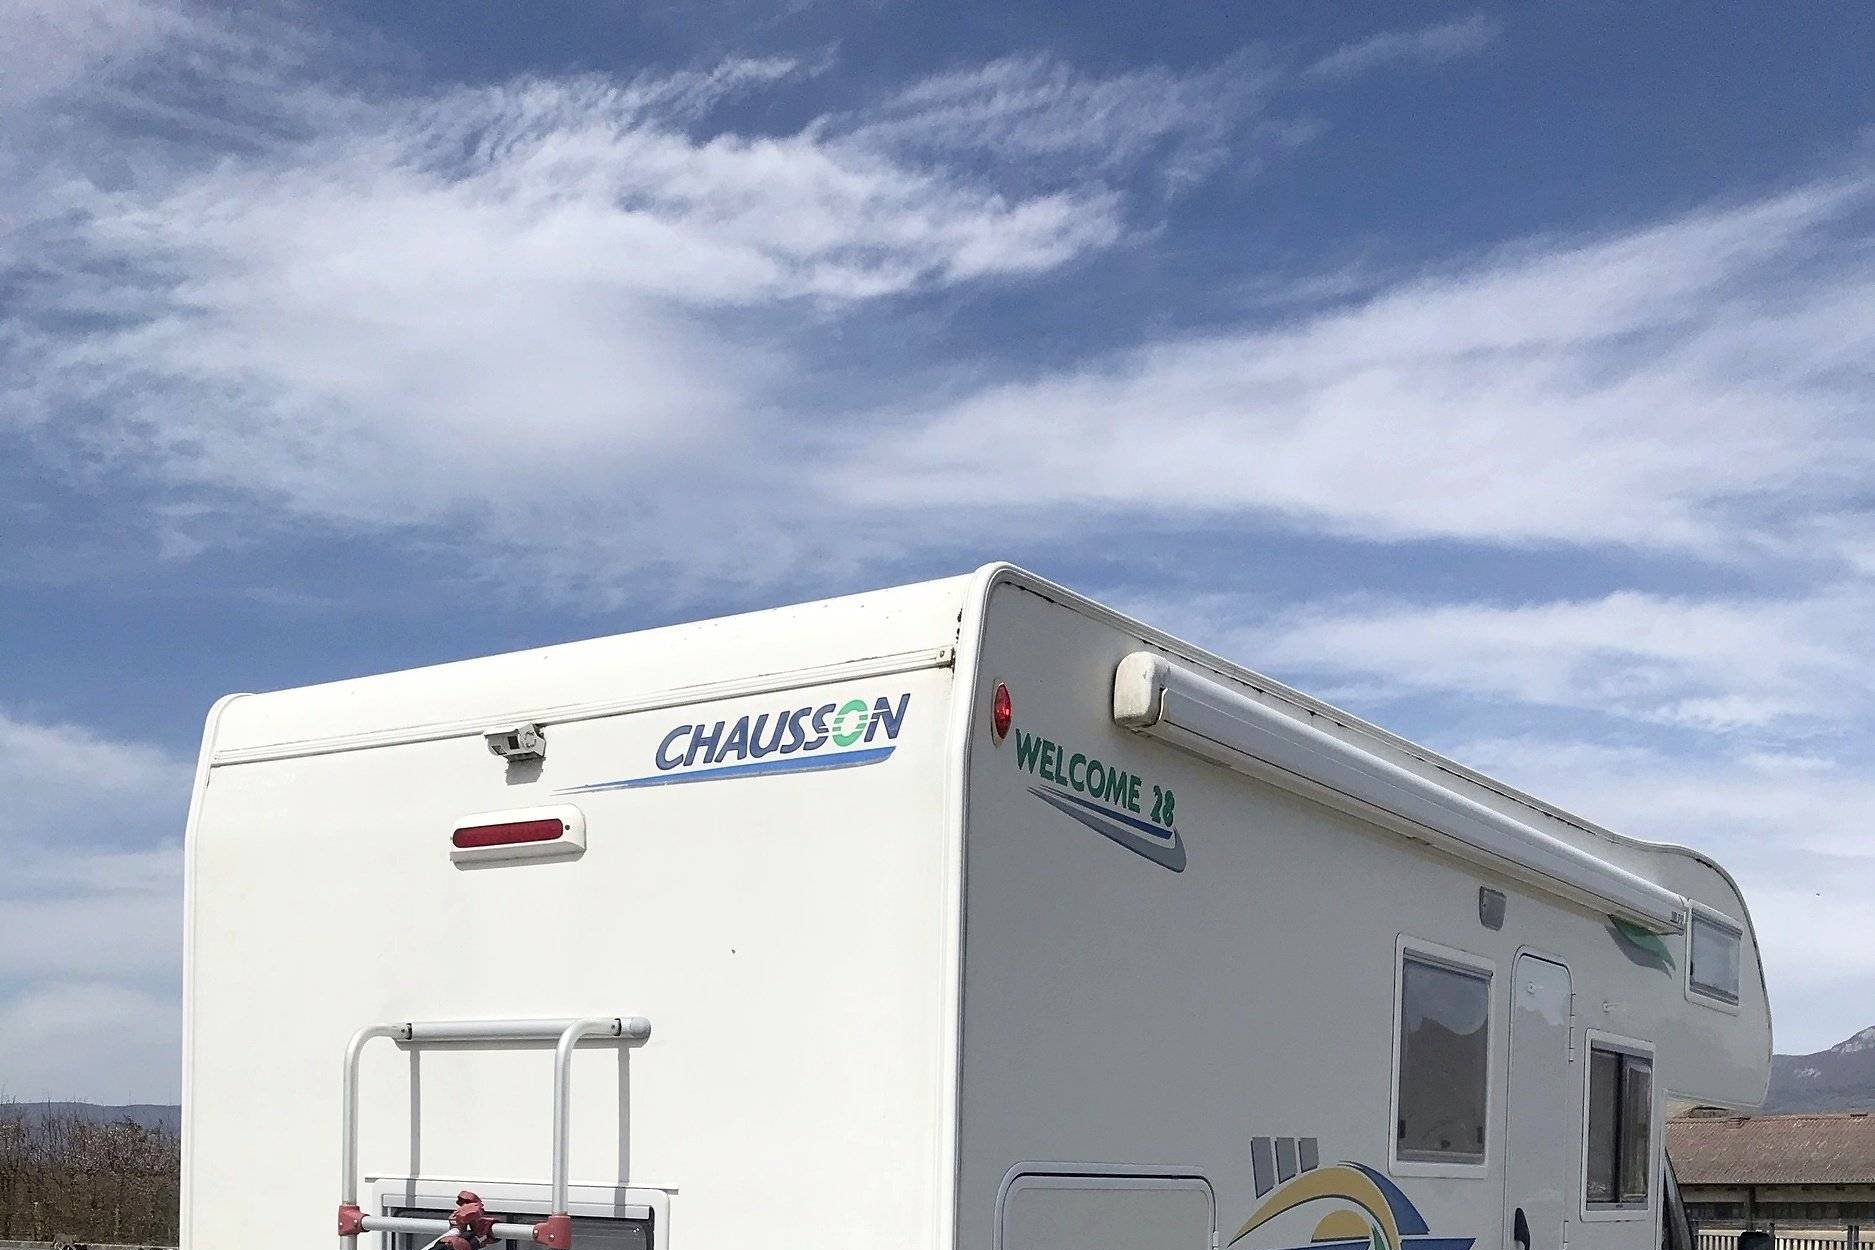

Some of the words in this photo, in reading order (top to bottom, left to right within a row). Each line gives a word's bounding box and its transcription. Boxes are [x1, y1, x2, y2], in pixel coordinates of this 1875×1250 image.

[655, 693, 911, 770] CHAUSSON
[1015, 728, 1142, 813] WELCOME
[1150, 784, 1175, 827] 28
